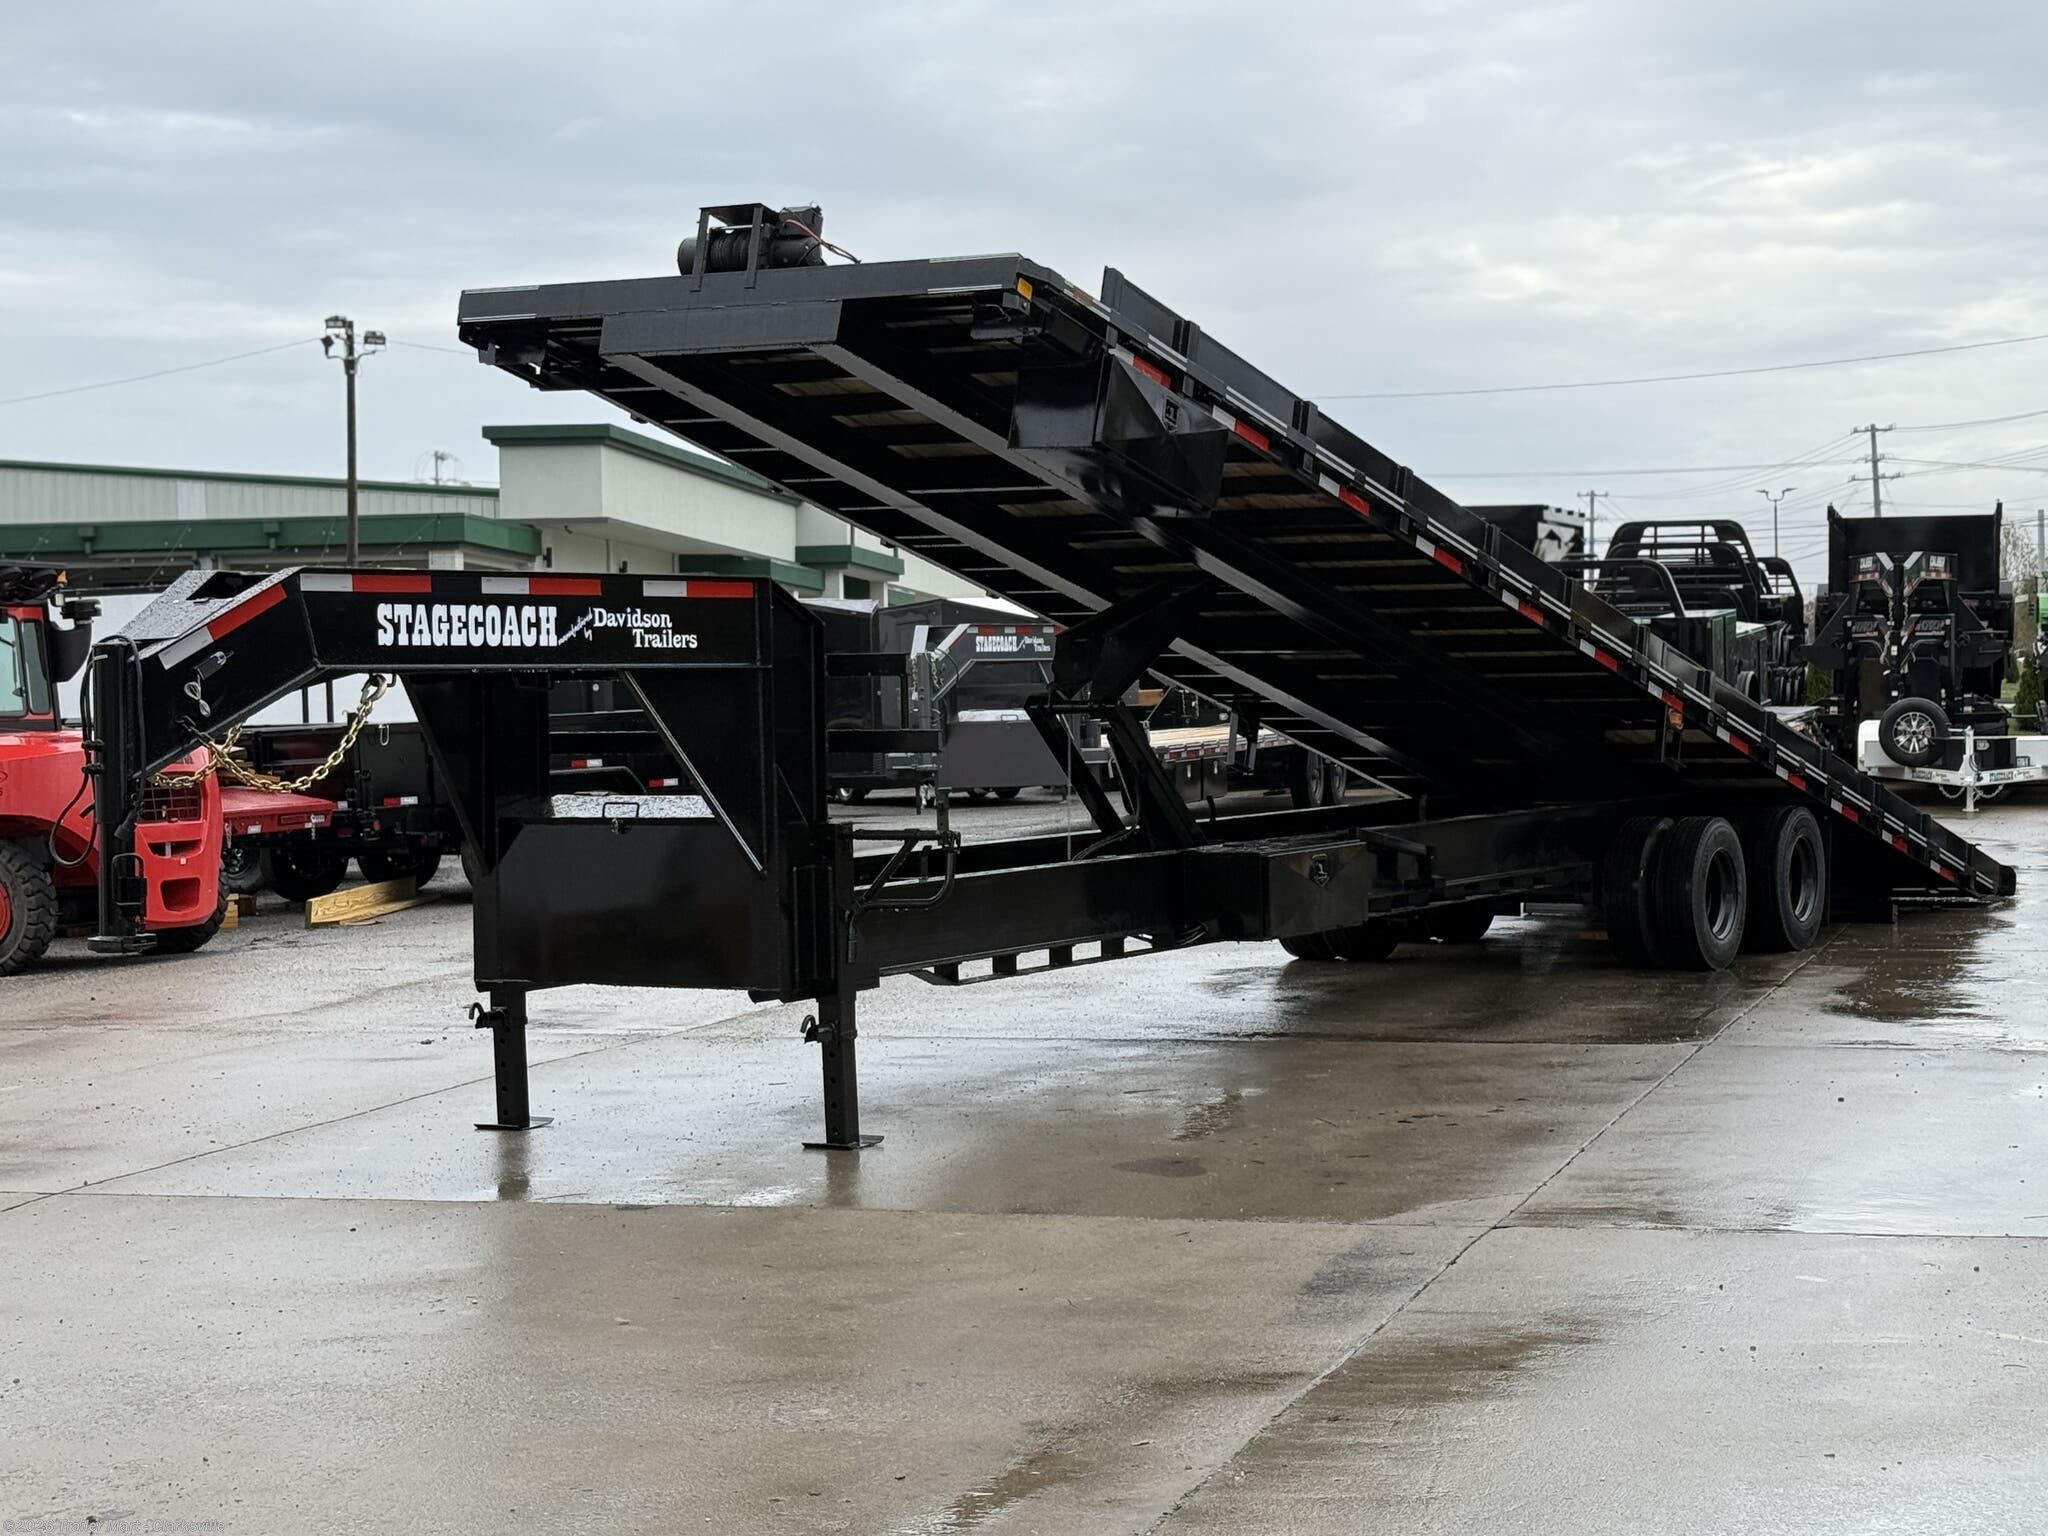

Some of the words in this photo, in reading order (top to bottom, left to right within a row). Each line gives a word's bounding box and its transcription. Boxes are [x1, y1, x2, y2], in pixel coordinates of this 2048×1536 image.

[377, 603, 558, 647] STAGECOACH
[593, 607, 673, 628] Davidson
[632, 628, 698, 649] Trailers
